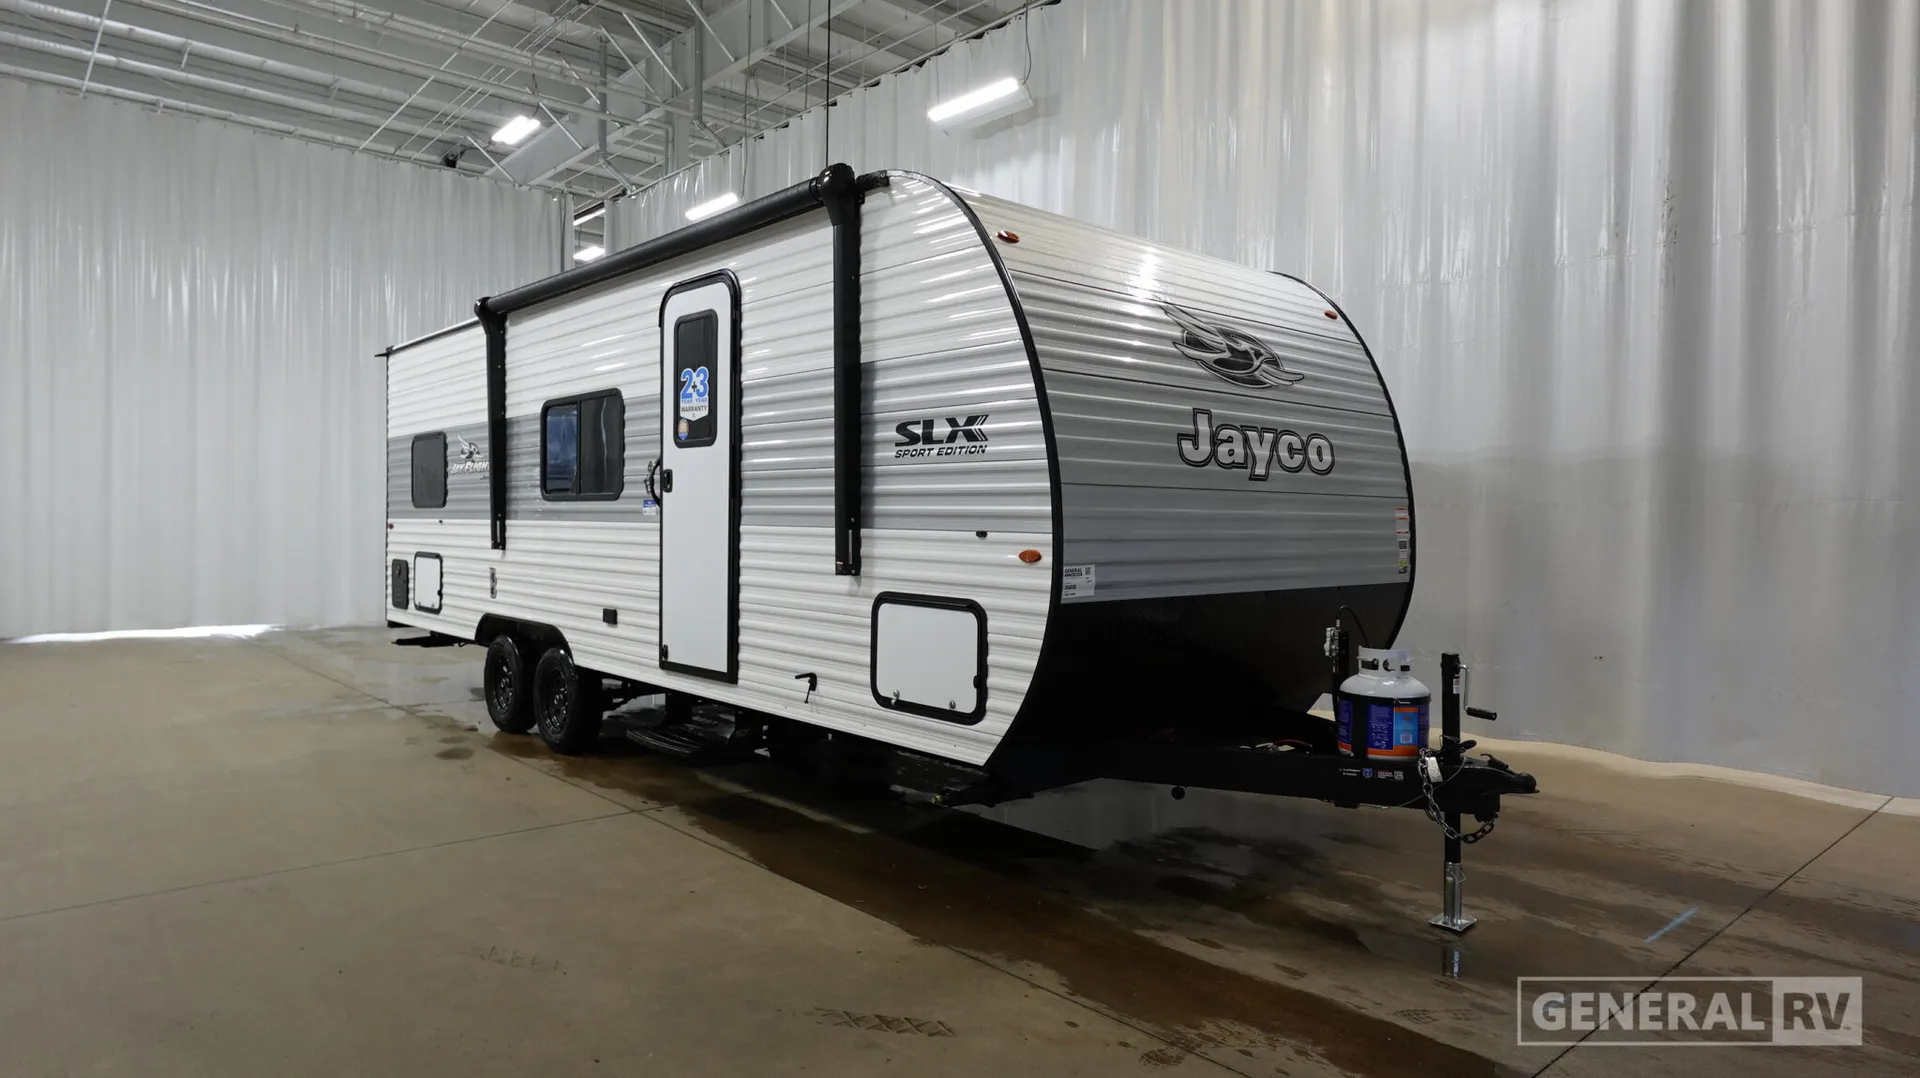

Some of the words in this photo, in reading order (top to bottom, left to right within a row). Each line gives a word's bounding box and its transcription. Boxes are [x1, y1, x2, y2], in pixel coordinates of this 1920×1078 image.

[895, 414, 989, 447] SLX
[1177, 408, 1335, 481] Jayco
[895, 447, 935, 458] SPORT
[937, 445, 988, 456] EDITION
